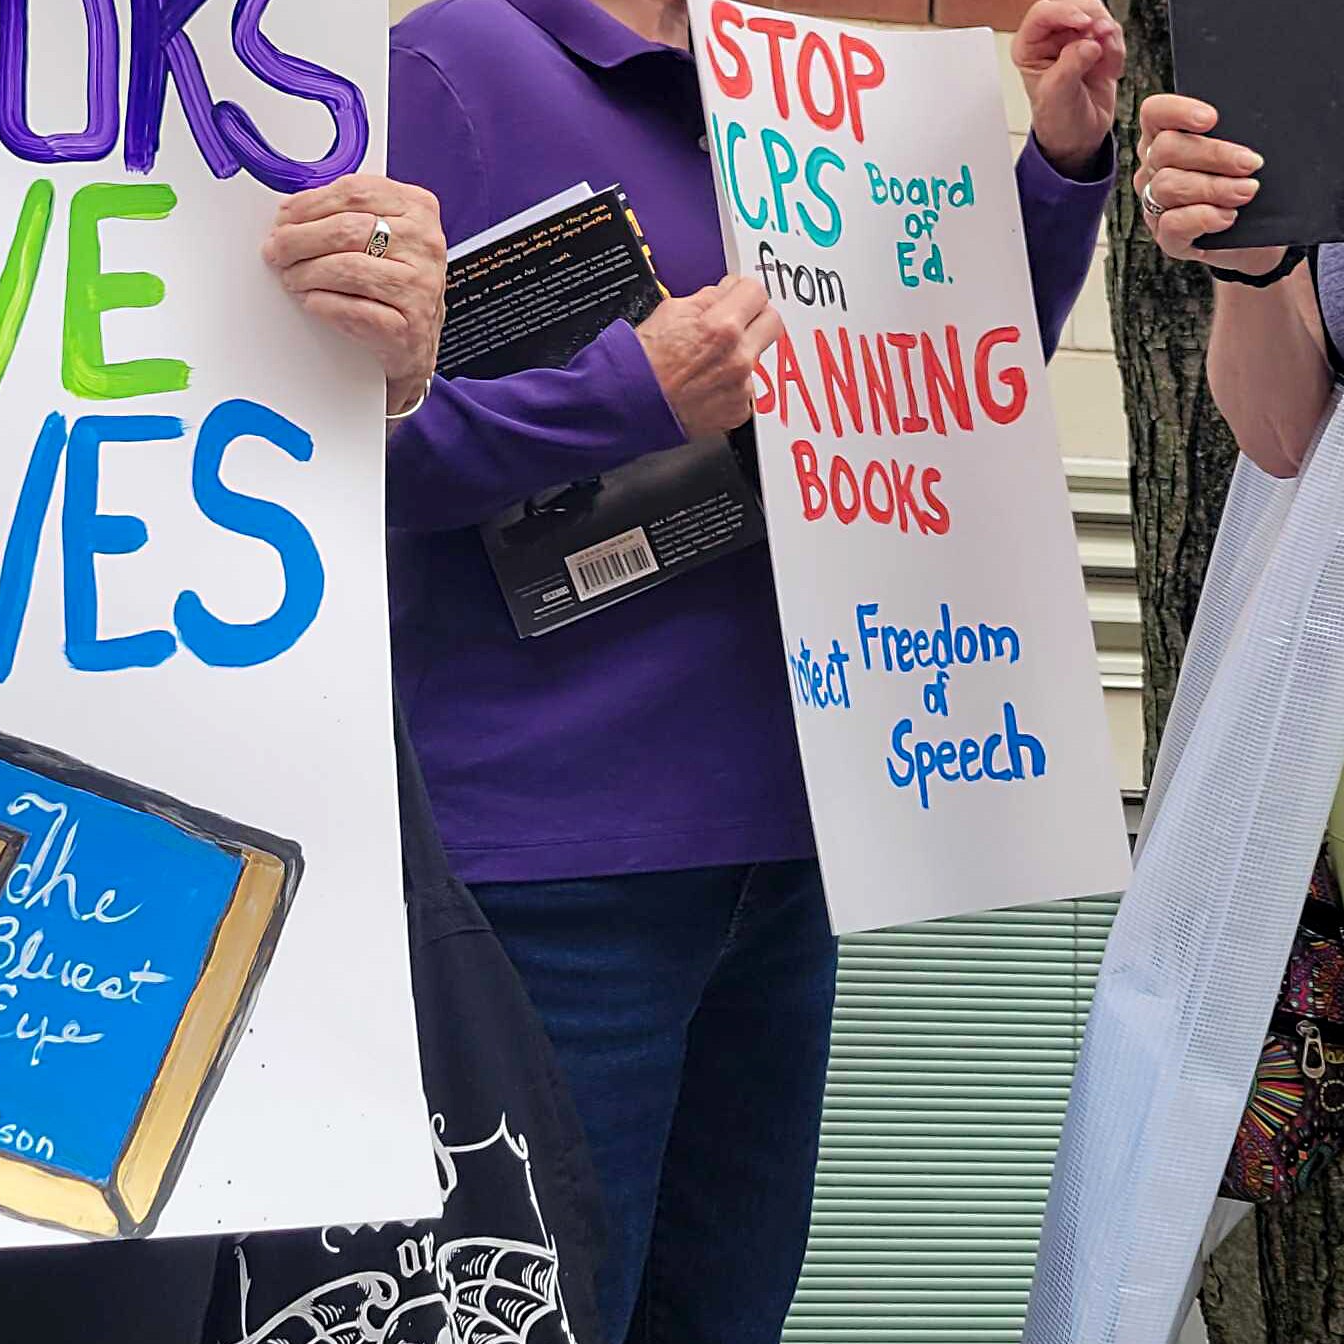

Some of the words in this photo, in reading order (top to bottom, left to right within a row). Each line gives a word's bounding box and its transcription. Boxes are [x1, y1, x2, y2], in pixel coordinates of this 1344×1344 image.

[706, 0, 885, 144] STOP
[864, 162, 975, 211] Board
[905, 209, 939, 240] of
[755, 240, 848, 311] from
[896, 241, 954, 288] Ed.
[790, 439, 951, 536] BOOKS
[856, 603, 1020, 673] Freedom
[923, 670, 950, 717] of
[887, 702, 1047, 810] Speech
[5, 791, 142, 926] The
